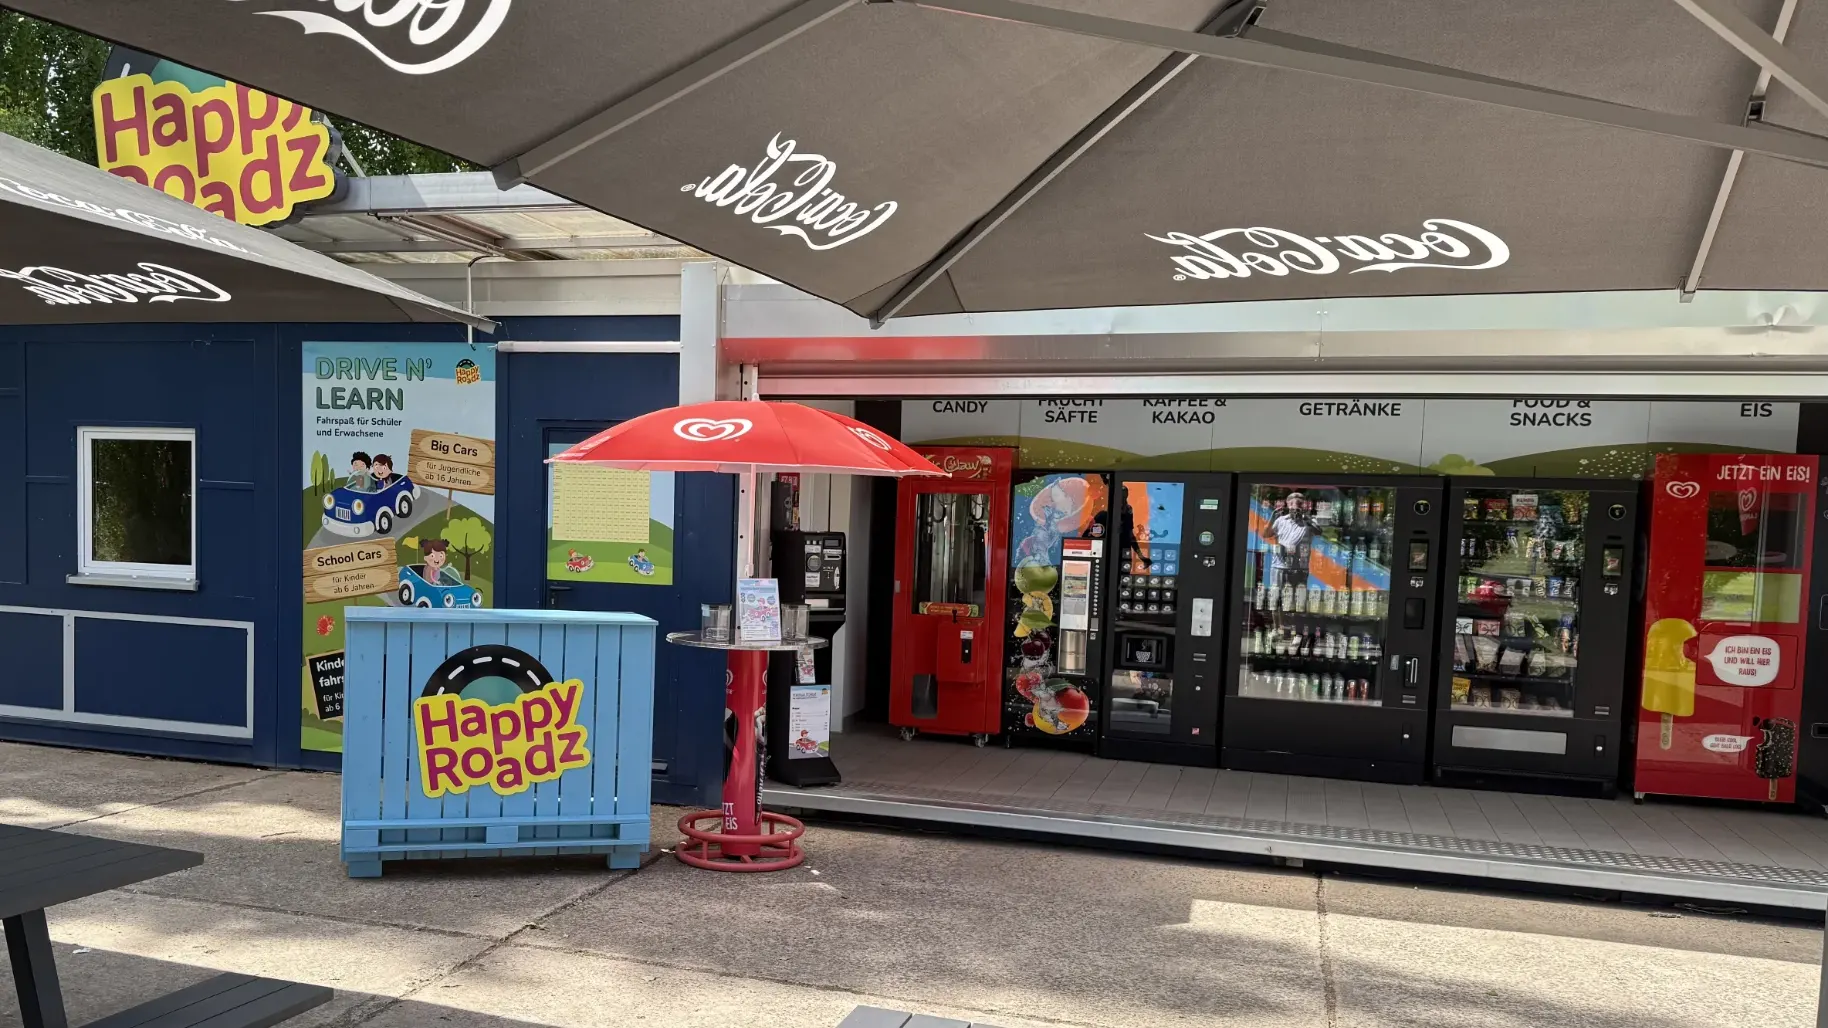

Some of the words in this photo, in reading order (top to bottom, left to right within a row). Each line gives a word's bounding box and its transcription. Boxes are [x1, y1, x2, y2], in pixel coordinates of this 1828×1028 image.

[101, 84, 304, 178] Happ
[315, 357, 397, 381] DRIVE
[456, 366, 478, 378] Happy
[315, 387, 404, 410] LEARN
[932, 401, 988, 413] CANDY
[1299, 399, 1402, 416] GETRÄNKE
[1741, 403, 1772, 417] EIS
[316, 416, 355, 426] Fahrspaß
[357, 417, 369, 425] für
[371, 418, 402, 426] Schüler
[1045, 407, 1098, 423] SÄFTE
[1152, 411, 1215, 424] KAKAO
[1510, 412, 1592, 426] SNACKS
[316, 428, 332, 437] und
[334, 428, 384, 437] Erwachsene
[431, 440, 449, 454] Big
[453, 443, 478, 457] Cars
[426, 462, 436, 470] für
[438, 464, 481, 477] Jugendliche
[1717, 464, 1754, 480] JETZT
[437, 474, 446, 482] 16
[447, 476, 472, 486] Jahren
[317, 552, 354, 567] School
[357, 550, 382, 561] Cars
[332, 576, 342, 584] für
[344, 573, 366, 583] Kinder
[334, 586, 343, 594] ab
[344, 584, 349, 593] 6
[351, 583, 374, 592] Jahren
[335, 703, 341, 711] 6
[421, 685, 577, 755] Happy
[426, 731, 584, 791] Roadz
